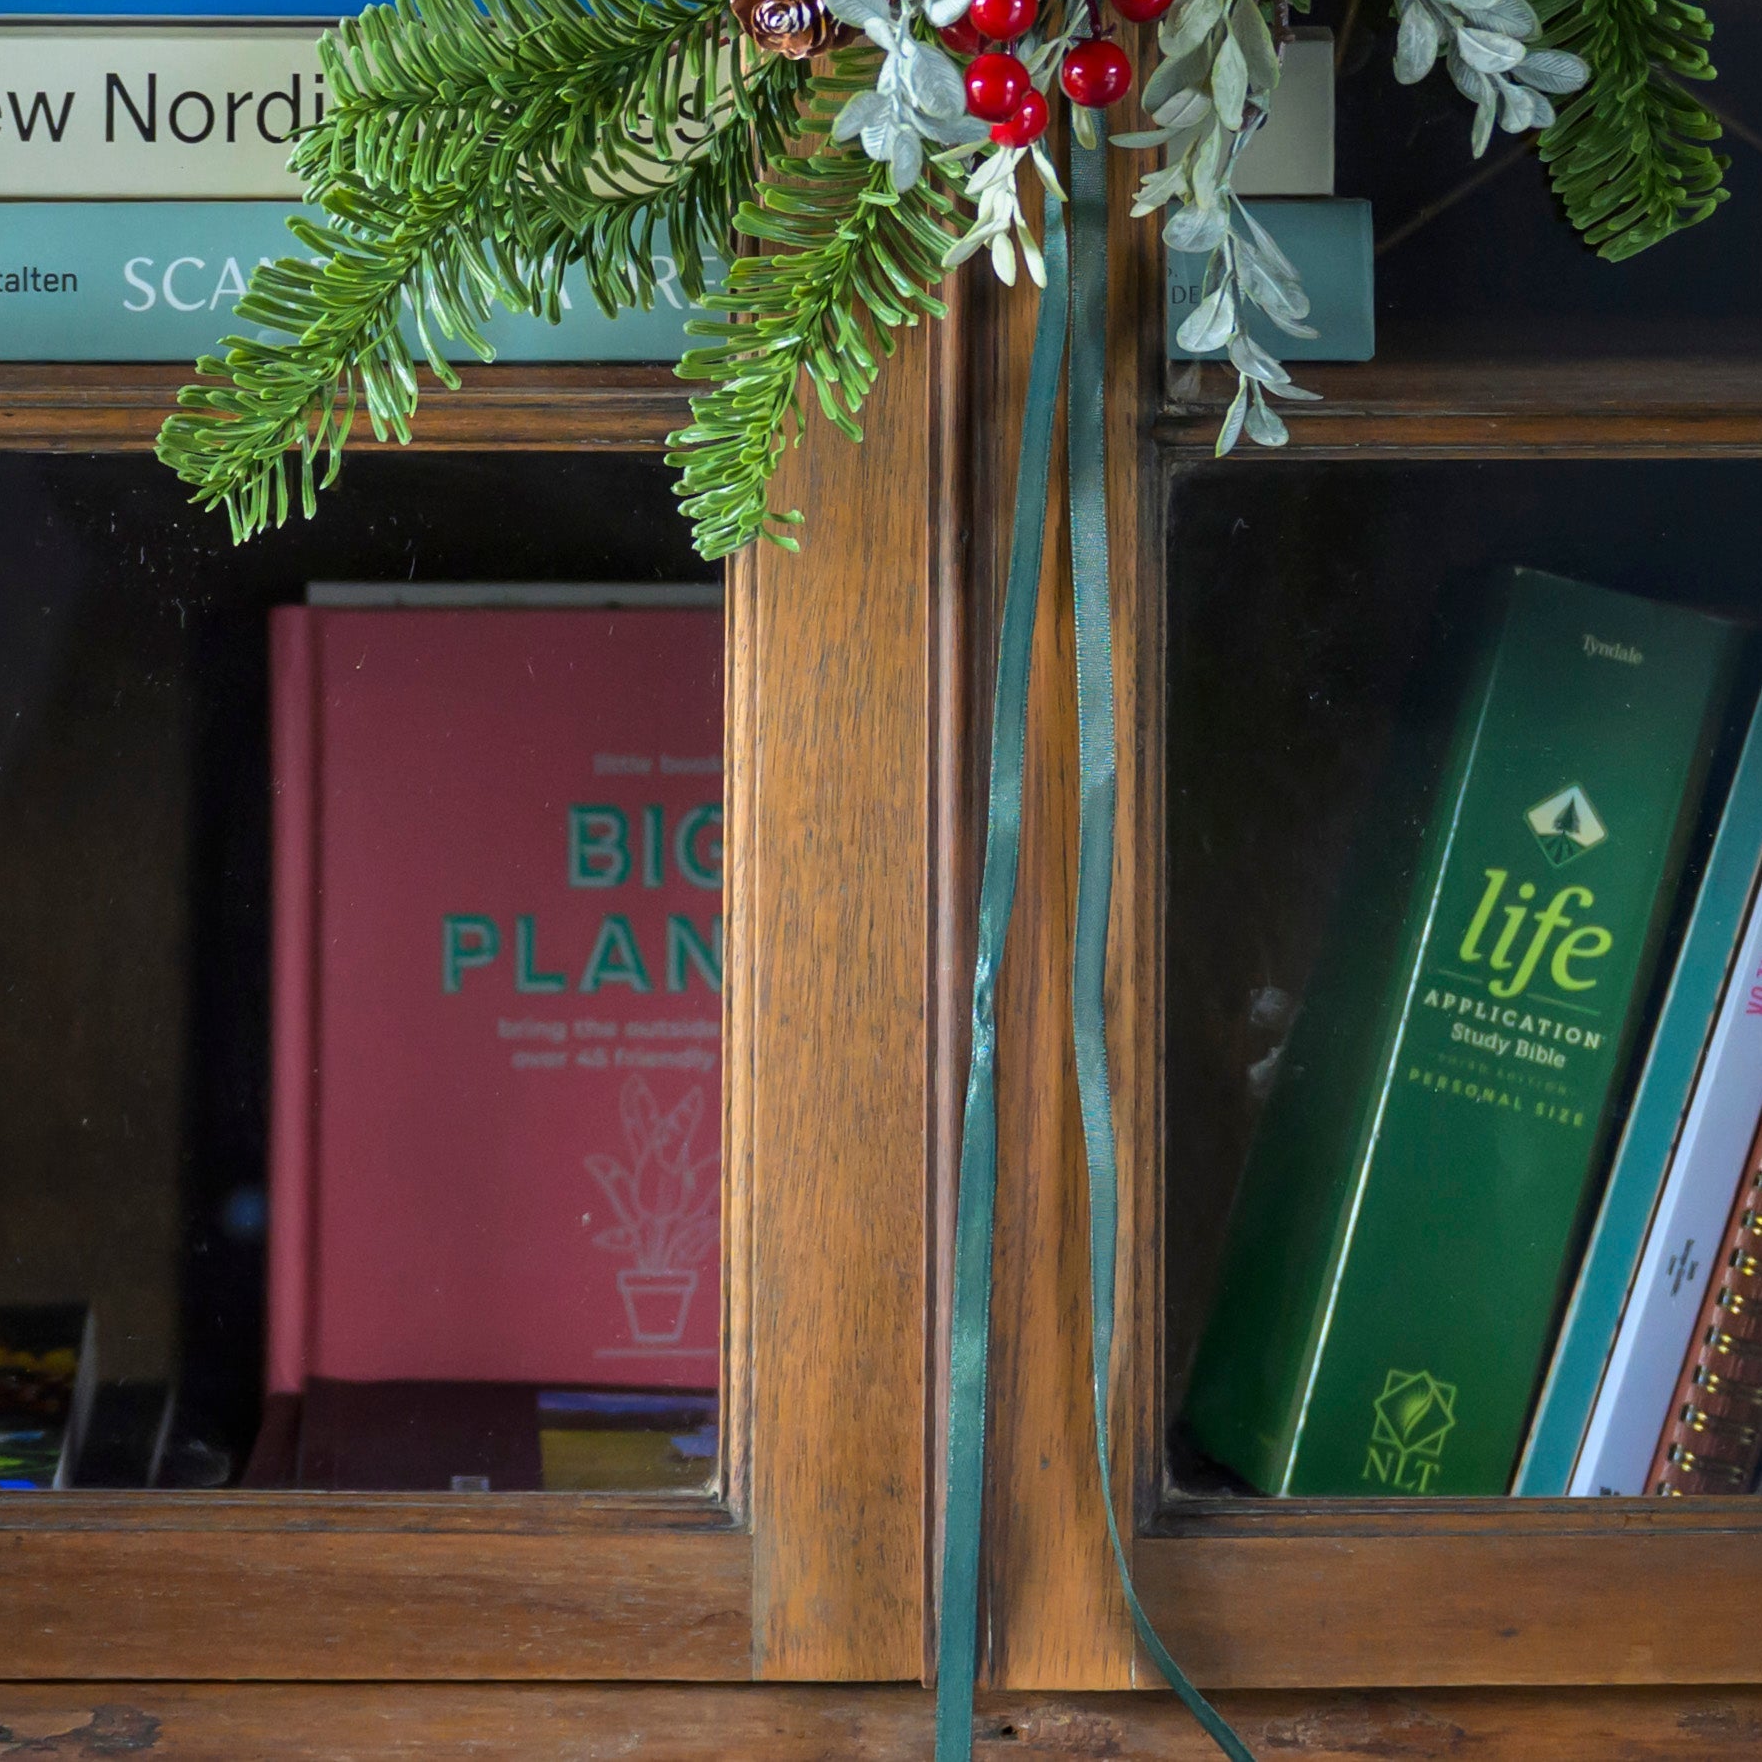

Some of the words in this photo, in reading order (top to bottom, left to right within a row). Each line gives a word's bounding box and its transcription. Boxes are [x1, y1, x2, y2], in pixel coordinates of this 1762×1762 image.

[104, 71, 326, 144] Nordi
[569, 803, 724, 889] BIG
[442, 913, 724, 993] PLAN
[1459, 868, 1613, 998] life
[1424, 989, 1601, 1050] APPLICATION
[1451, 1022, 1511, 1056] Study
[1515, 1038, 1566, 1070] Bible
[1408, 1067, 1522, 1112] PERSONAL
[1534, 1101, 1584, 1128] SIZE
[1361, 1446, 1440, 1494] NLT
